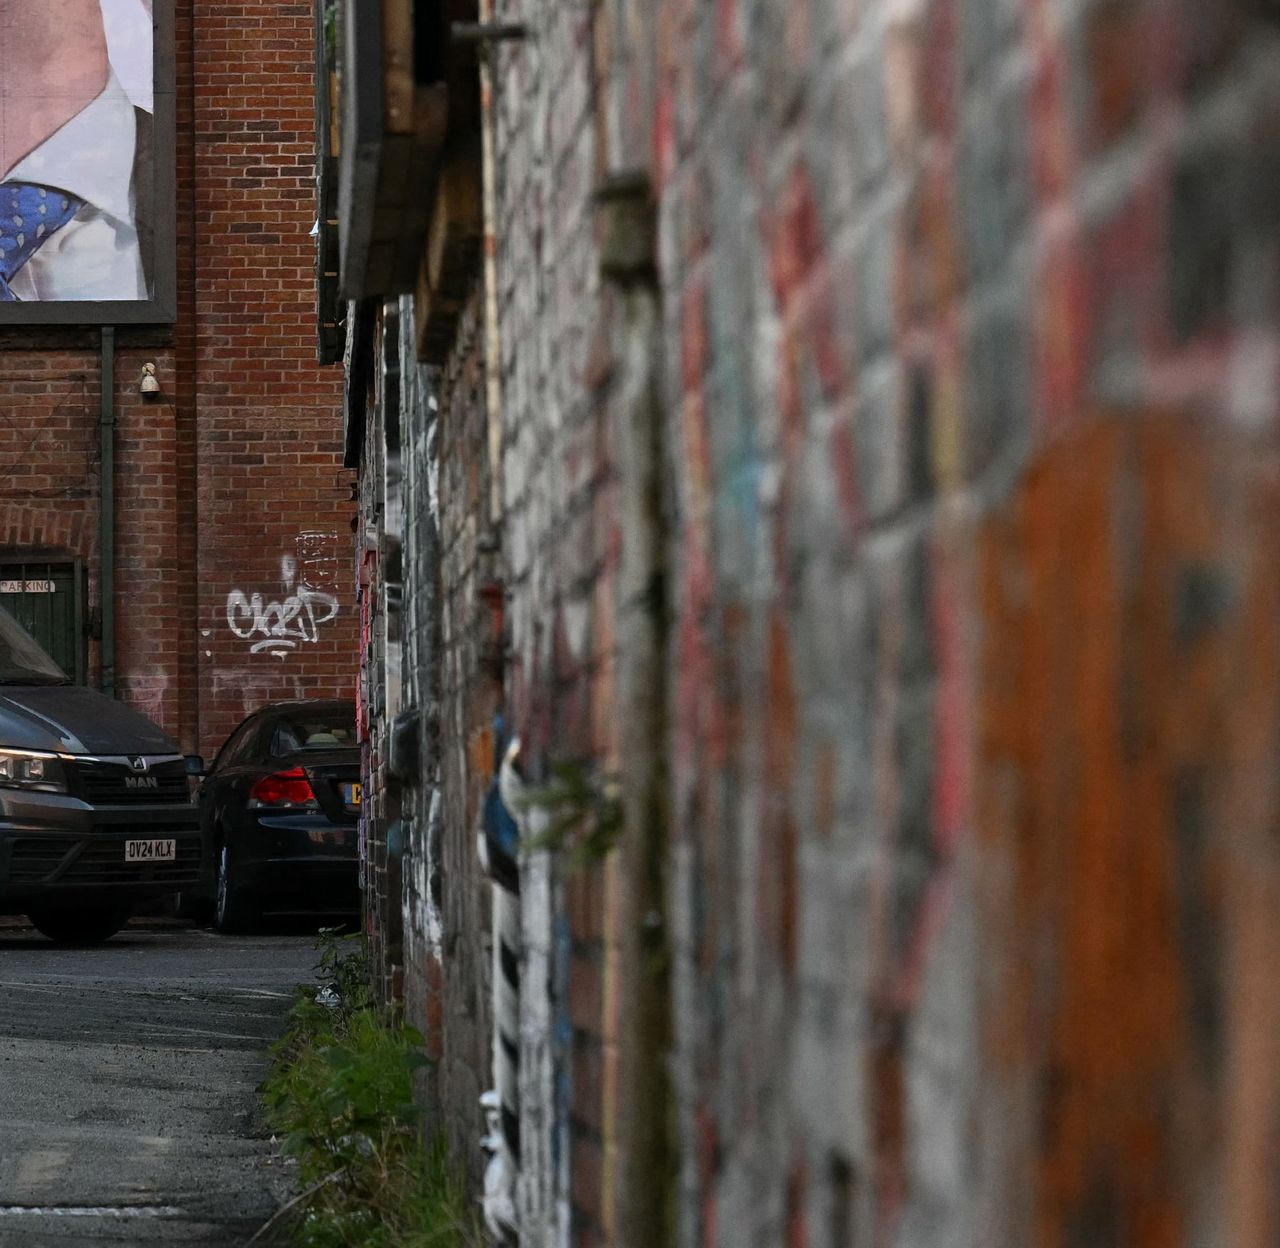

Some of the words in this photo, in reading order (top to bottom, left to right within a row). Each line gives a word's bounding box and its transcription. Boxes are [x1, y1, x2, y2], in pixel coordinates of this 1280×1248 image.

[125, 776, 158, 788] MAN
[129, 841, 153, 858] OV24
[155, 841, 172, 857] KLX
